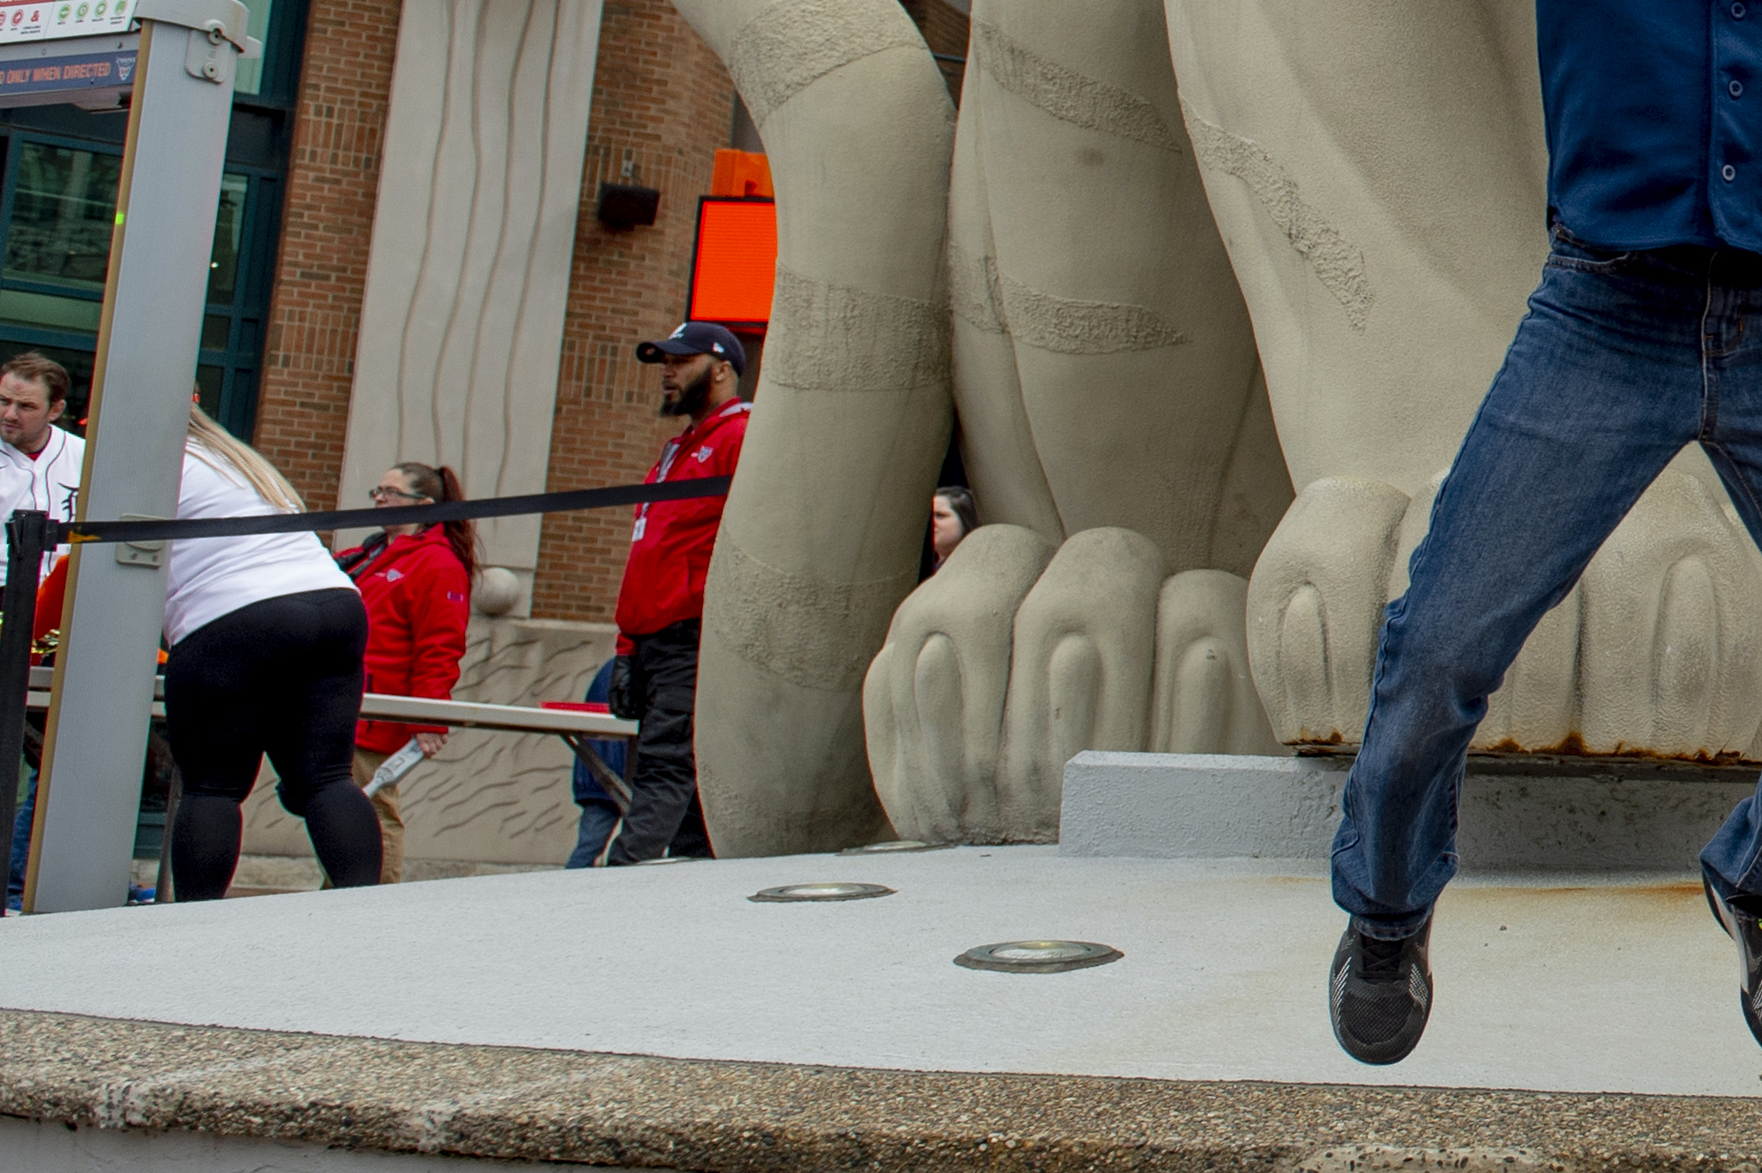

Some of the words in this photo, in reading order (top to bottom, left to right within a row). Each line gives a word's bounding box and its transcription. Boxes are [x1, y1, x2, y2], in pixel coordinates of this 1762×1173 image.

[6, 69, 31, 84] ONLY
[32, 66, 62, 82] WHEN
[62, 62, 111, 80] DIRECTED
